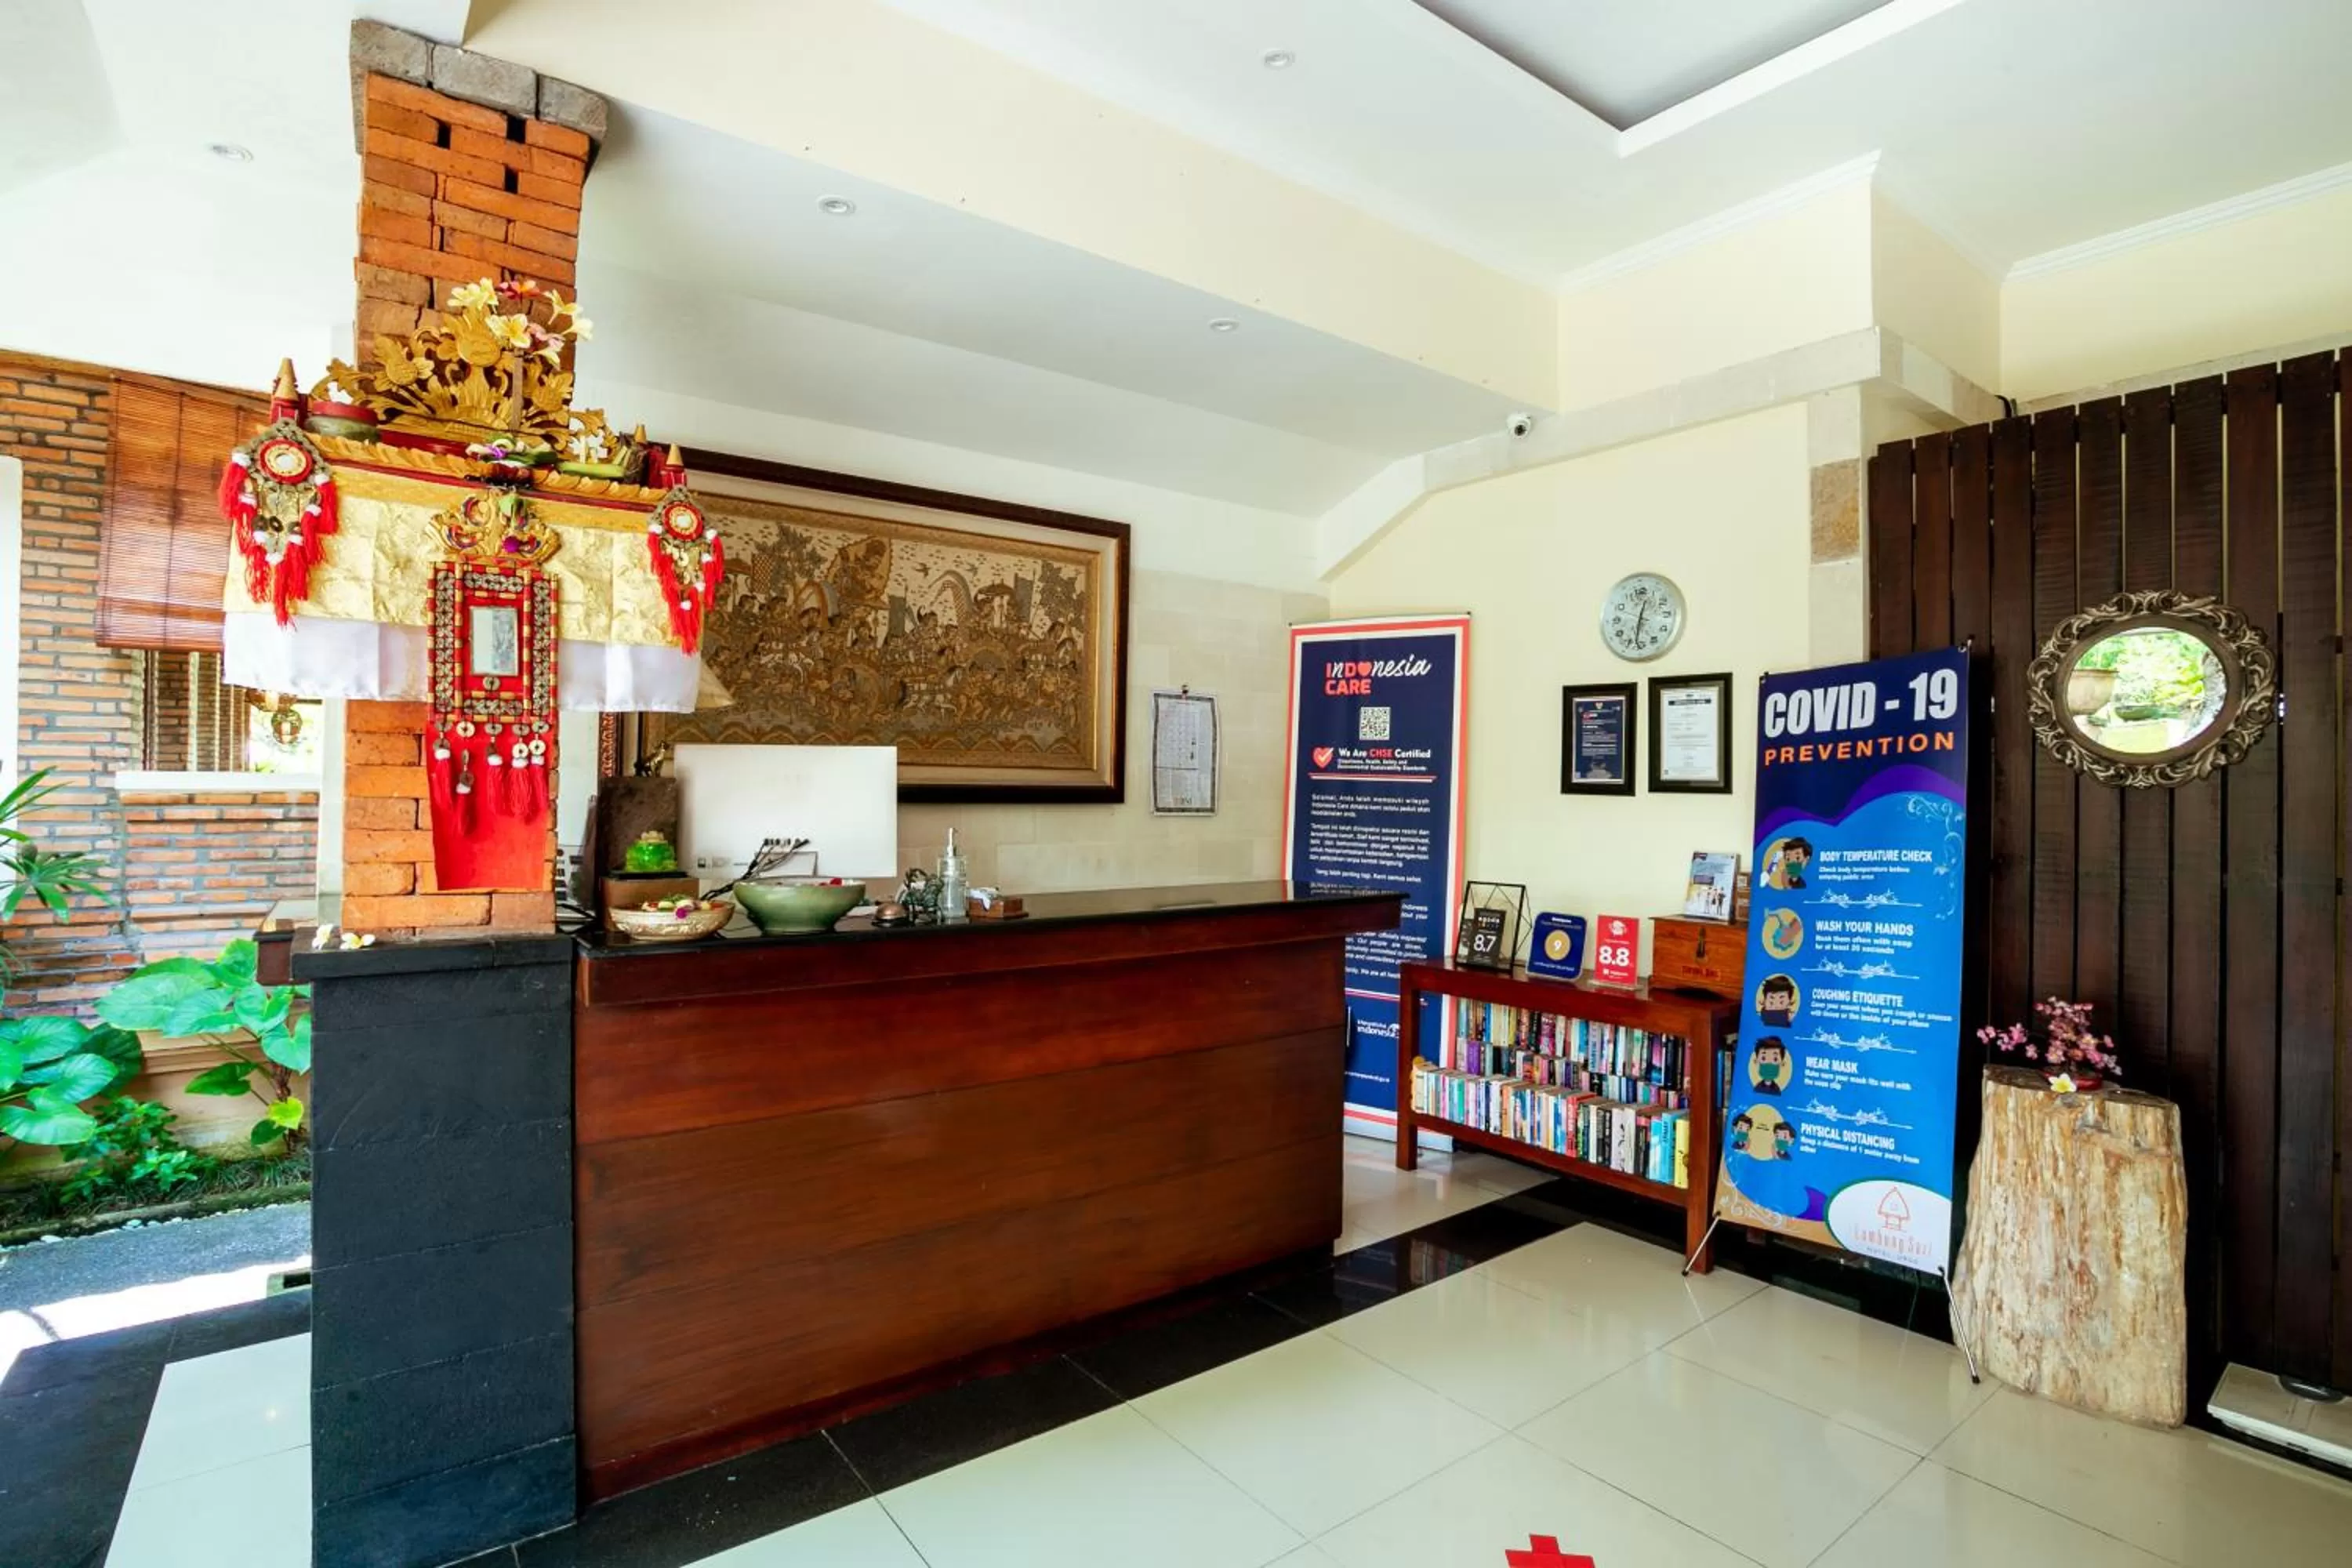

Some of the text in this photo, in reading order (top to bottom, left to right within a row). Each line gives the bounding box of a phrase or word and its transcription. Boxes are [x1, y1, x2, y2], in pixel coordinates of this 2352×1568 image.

[1325, 679, 1371, 695] CARE
[1765, 681, 1876, 738] COVID
[1908, 669, 1958, 721] 19
[1339, 748, 1351, 757] We
[1395, 749, 1431, 758] Certified
[1765, 731, 1954, 766] PREVENTION
[1820, 850, 1932, 862] BODY TEMPERATURE CHECK
[1816, 920, 1914, 937] WASH YOUR HANDS
[1474, 934, 1497, 952] 8.7
[1554, 940, 1562, 951] 9
[1599, 945, 1629, 967] 8.8
[1812, 988, 1904, 1007] COUGHING ETIQUETTE
[1806, 1056, 1858, 1073] WEAR MASK
[1801, 1123, 1895, 1150] PHYSICAL DISTANCING
